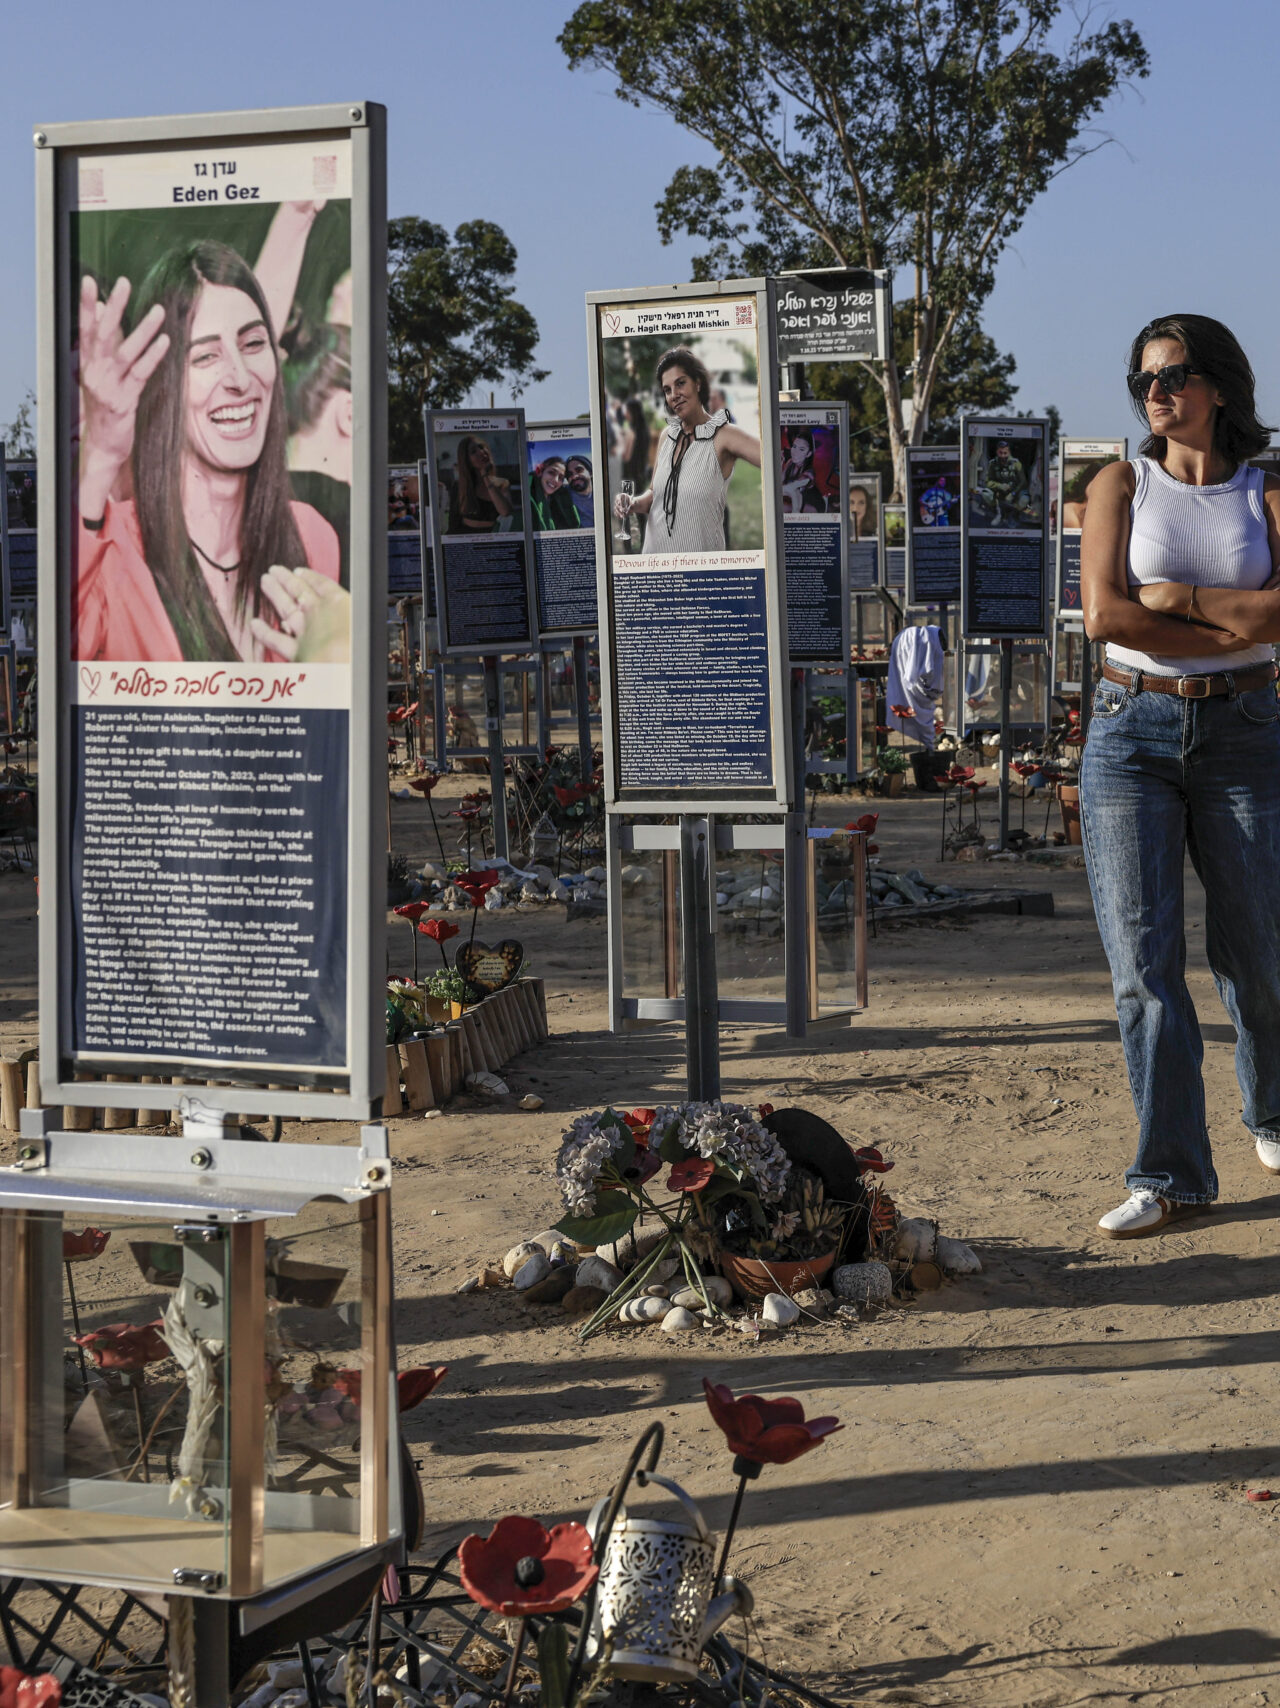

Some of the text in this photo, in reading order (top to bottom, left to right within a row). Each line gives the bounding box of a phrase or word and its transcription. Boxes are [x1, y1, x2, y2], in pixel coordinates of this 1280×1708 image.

[194, 161, 236, 178] עדן גז
[173, 184, 260, 202] Eden Gez
[638, 314, 662, 323] מישקין
[664, 312, 686, 320] רפאלי
[813, 312, 837, 327] עפר
[638, 324, 659, 334] Hagit
[662, 322, 696, 332] Raphaeli
[699, 320, 729, 328] Mishkin
[648, 557, 659, 571] life
[672, 556, 679, 570] if
[680, 556, 698, 566] there
[701, 557, 707, 565] is
[175, 671, 226, 697] טובה
[228, 677, 264, 697] הכי
[85, 712, 300, 725] 31 years old, from Ashkelon. Daughter to Aliza and
[85, 724, 114, 732] Robert
[116, 724, 133, 732] and
[134, 724, 159, 733] sister
[160, 725, 170, 733] to
[171, 725, 188, 733] four
[225, 726, 267, 736] including
[269, 726, 284, 734] her
[286, 726, 306, 735] twin
[85, 734, 130, 743] sister Adi.
[87, 1036, 111, 1047] Eden,
[127, 1038, 144, 1047] love
[147, 1041, 163, 1050] you
[164, 1040, 179, 1049] and
[180, 1041, 196, 1050] will
[196, 1042, 216, 1051] miss
[217, 1045, 232, 1055] you
[234, 1044, 269, 1055] forever.
